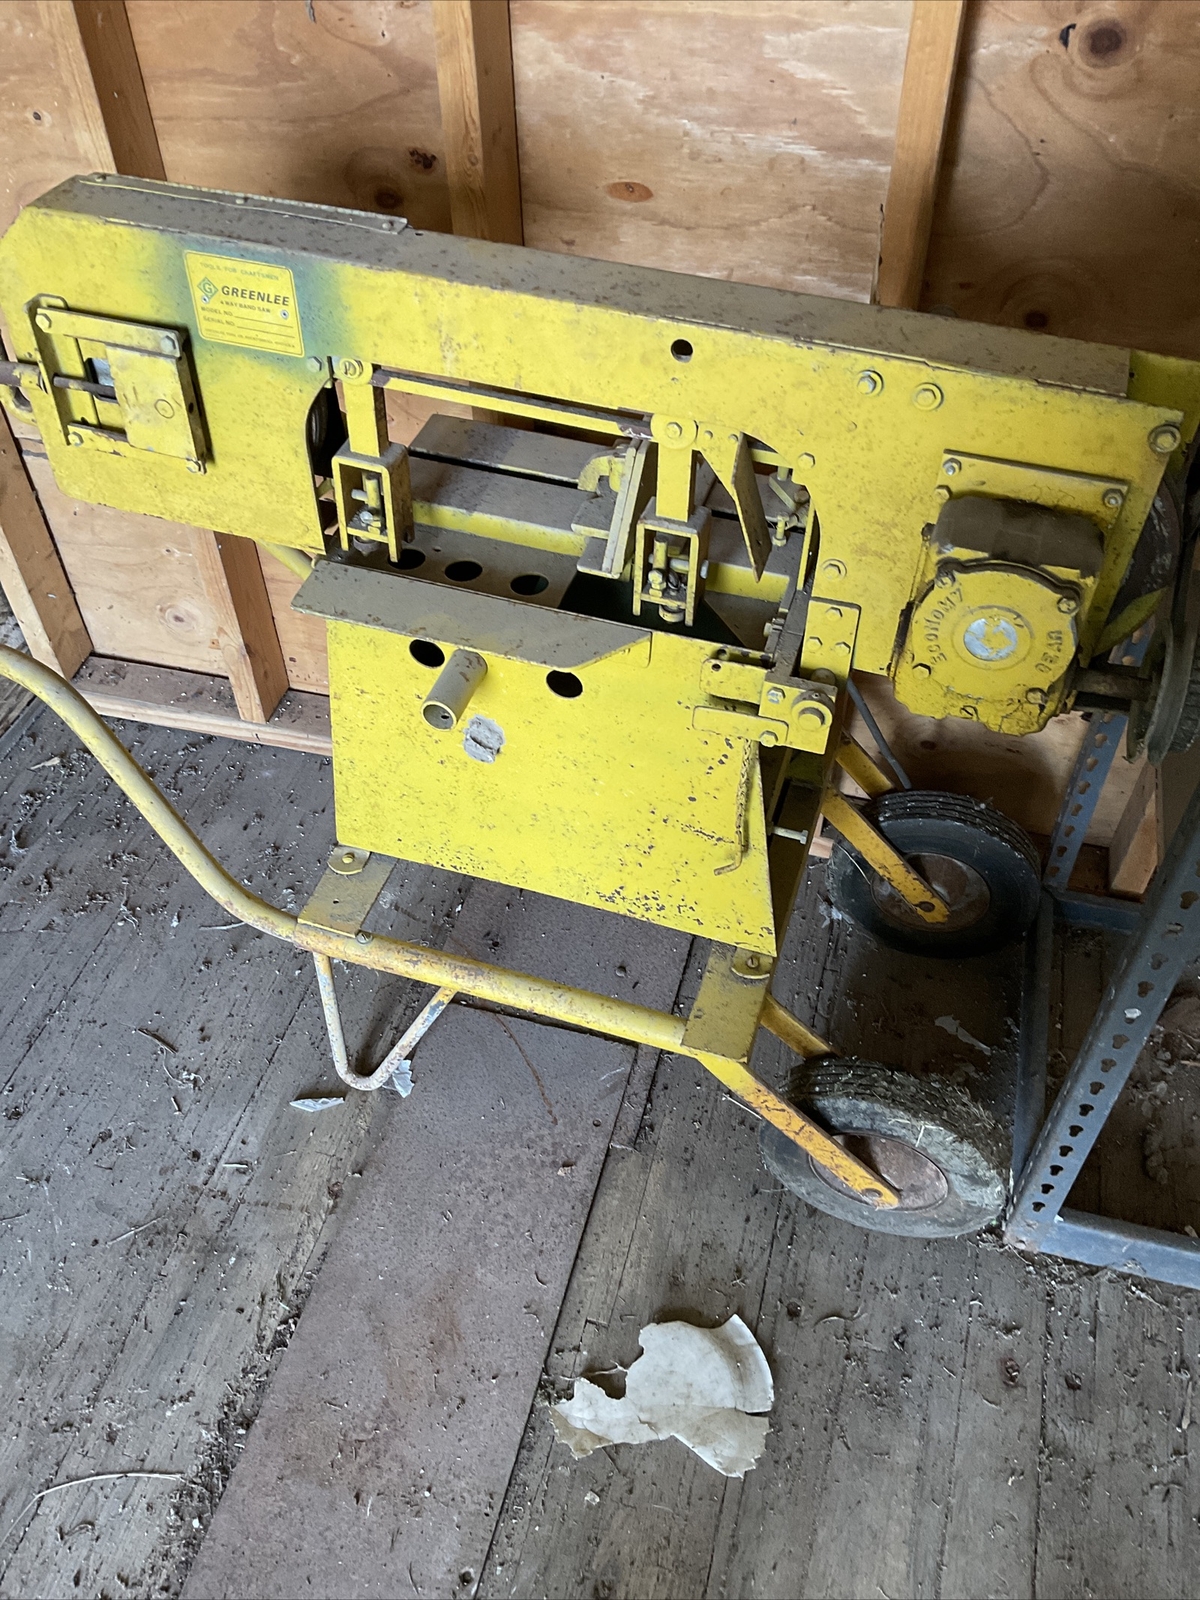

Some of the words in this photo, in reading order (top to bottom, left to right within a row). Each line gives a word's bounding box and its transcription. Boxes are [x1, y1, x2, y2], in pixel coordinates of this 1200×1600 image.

[221, 285, 290, 306] GREENLEE
[201, 306, 222, 315] MODEL
[239, 303, 256, 311] BAND
[257, 305, 271, 313] SAW
[203, 316, 225, 325] SERIAL
[924, 588, 963, 666] ECONOMY
[1035, 630, 1063, 674] GEAR
